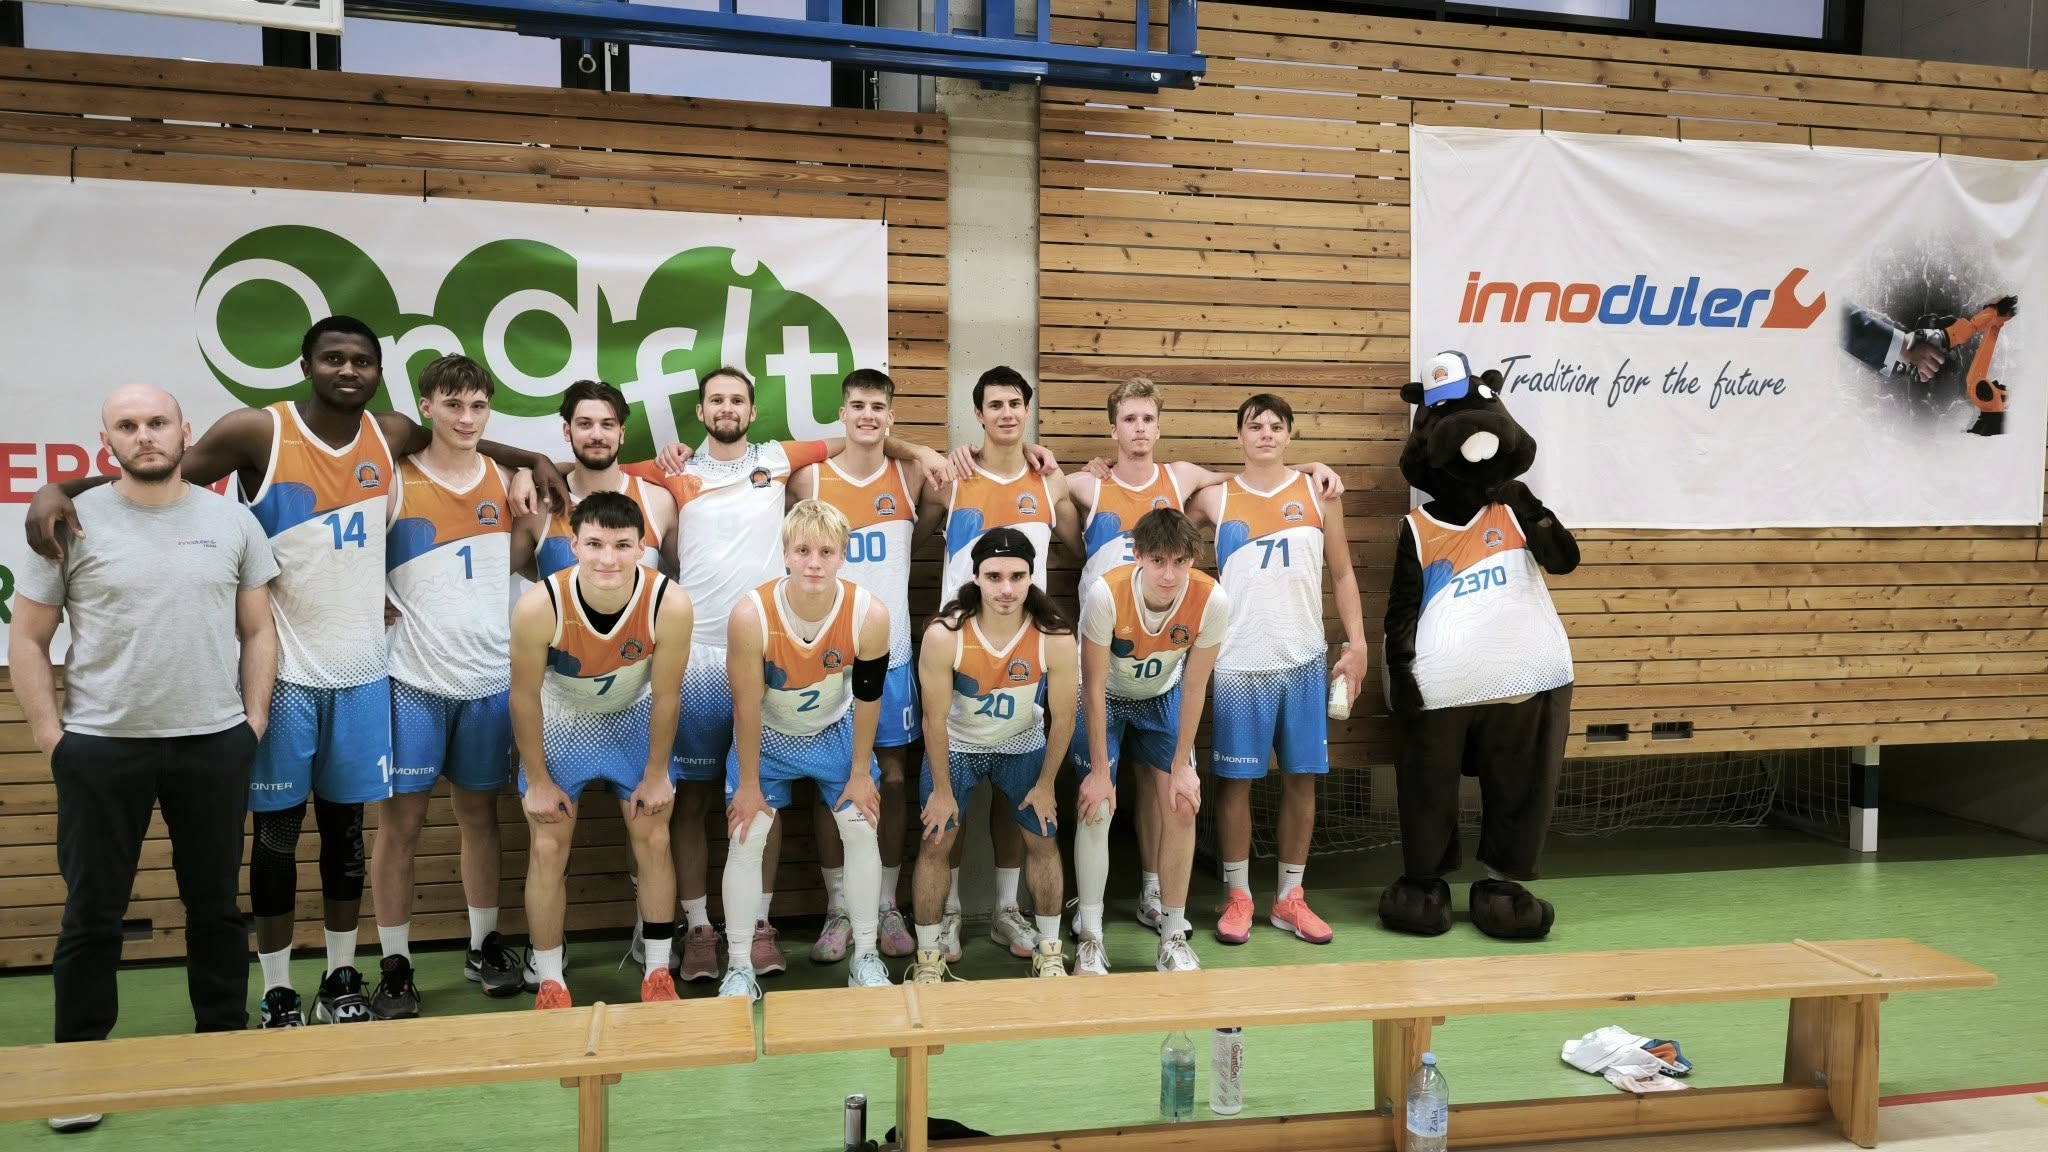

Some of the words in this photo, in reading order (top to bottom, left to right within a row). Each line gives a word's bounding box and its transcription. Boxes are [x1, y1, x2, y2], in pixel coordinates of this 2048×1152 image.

[1458, 272, 1771, 328] innoduler
[1498, 354, 1600, 396] Tradition
[1606, 358, 1651, 408] for
[1662, 361, 1701, 396] the
[1709, 360, 1787, 409] future
[322, 511, 367, 550] 14
[846, 531, 886, 563] 00
[1256, 538, 1290, 569] 71
[455, 545, 473, 580] 1
[1450, 565, 1507, 598] 2370
[1132, 658, 1163, 679] 10
[593, 674, 617, 696] 7
[797, 690, 820, 712] 2
[974, 692, 1015, 720] 20
[393, 766, 435, 776] MONTER
[673, 755, 716, 765] MONTER
[1221, 755, 1259, 764] MONTER
[251, 782, 293, 791] ONTER
